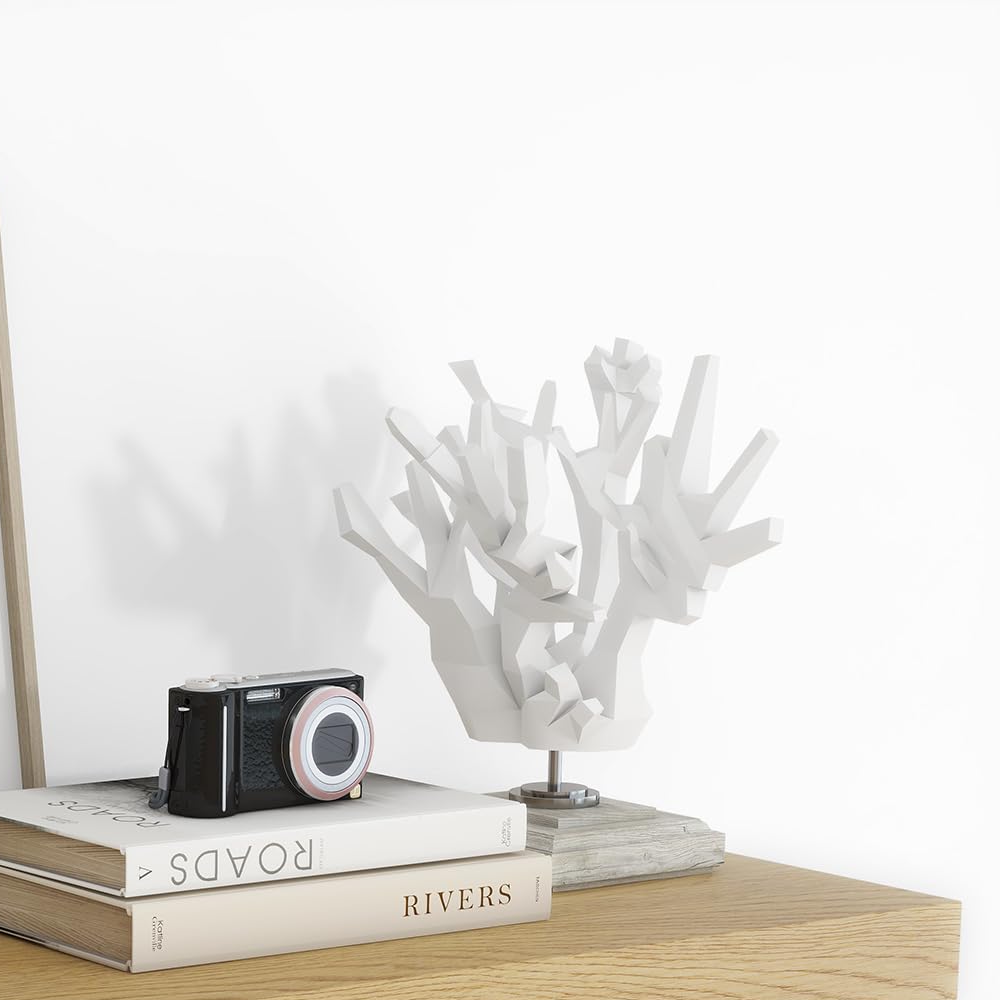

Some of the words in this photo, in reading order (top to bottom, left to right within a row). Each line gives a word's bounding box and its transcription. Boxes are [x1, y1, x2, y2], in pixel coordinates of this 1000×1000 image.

[47, 800, 171, 828] ROADS
[170, 839, 313, 886] ROADS
[403, 883, 512, 918] RIVERS
